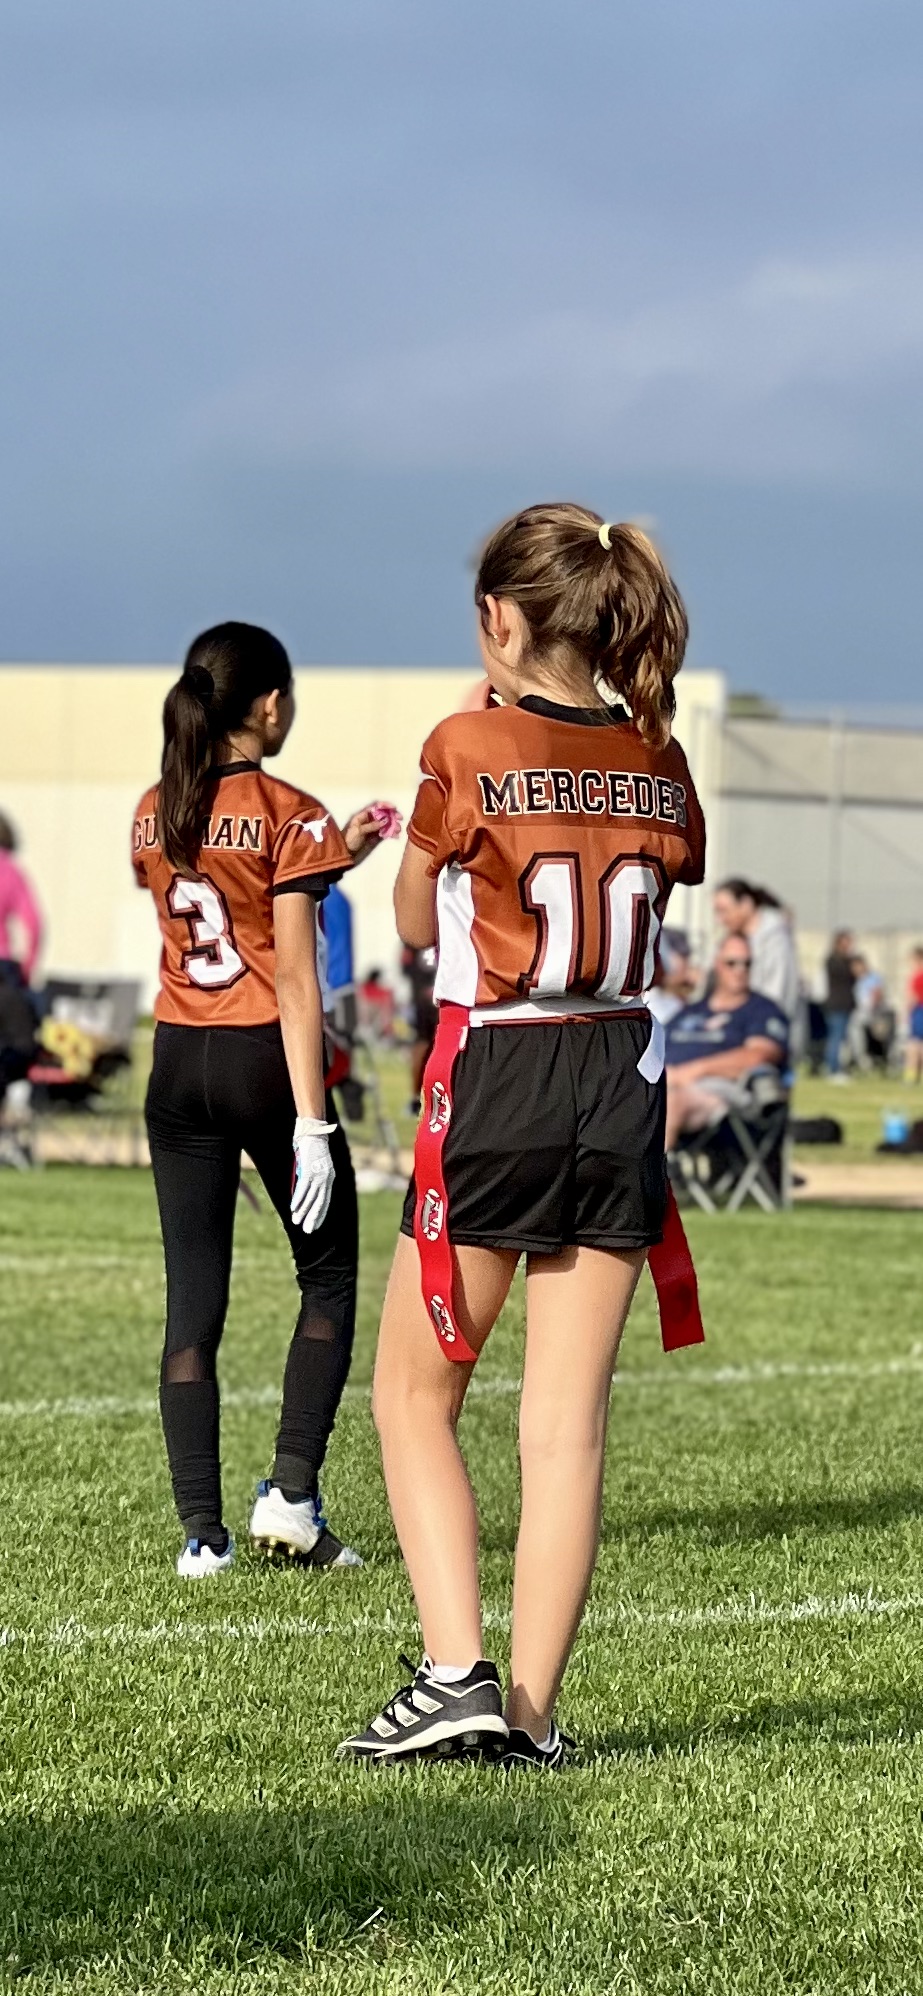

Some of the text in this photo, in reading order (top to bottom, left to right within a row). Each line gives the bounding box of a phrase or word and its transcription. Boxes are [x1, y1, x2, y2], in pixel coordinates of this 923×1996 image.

[133, 814, 262, 852] GUAN
[477, 768, 687, 827] MERCEDES
[165, 872, 248, 992] 3
[517, 852, 670, 999] 10
